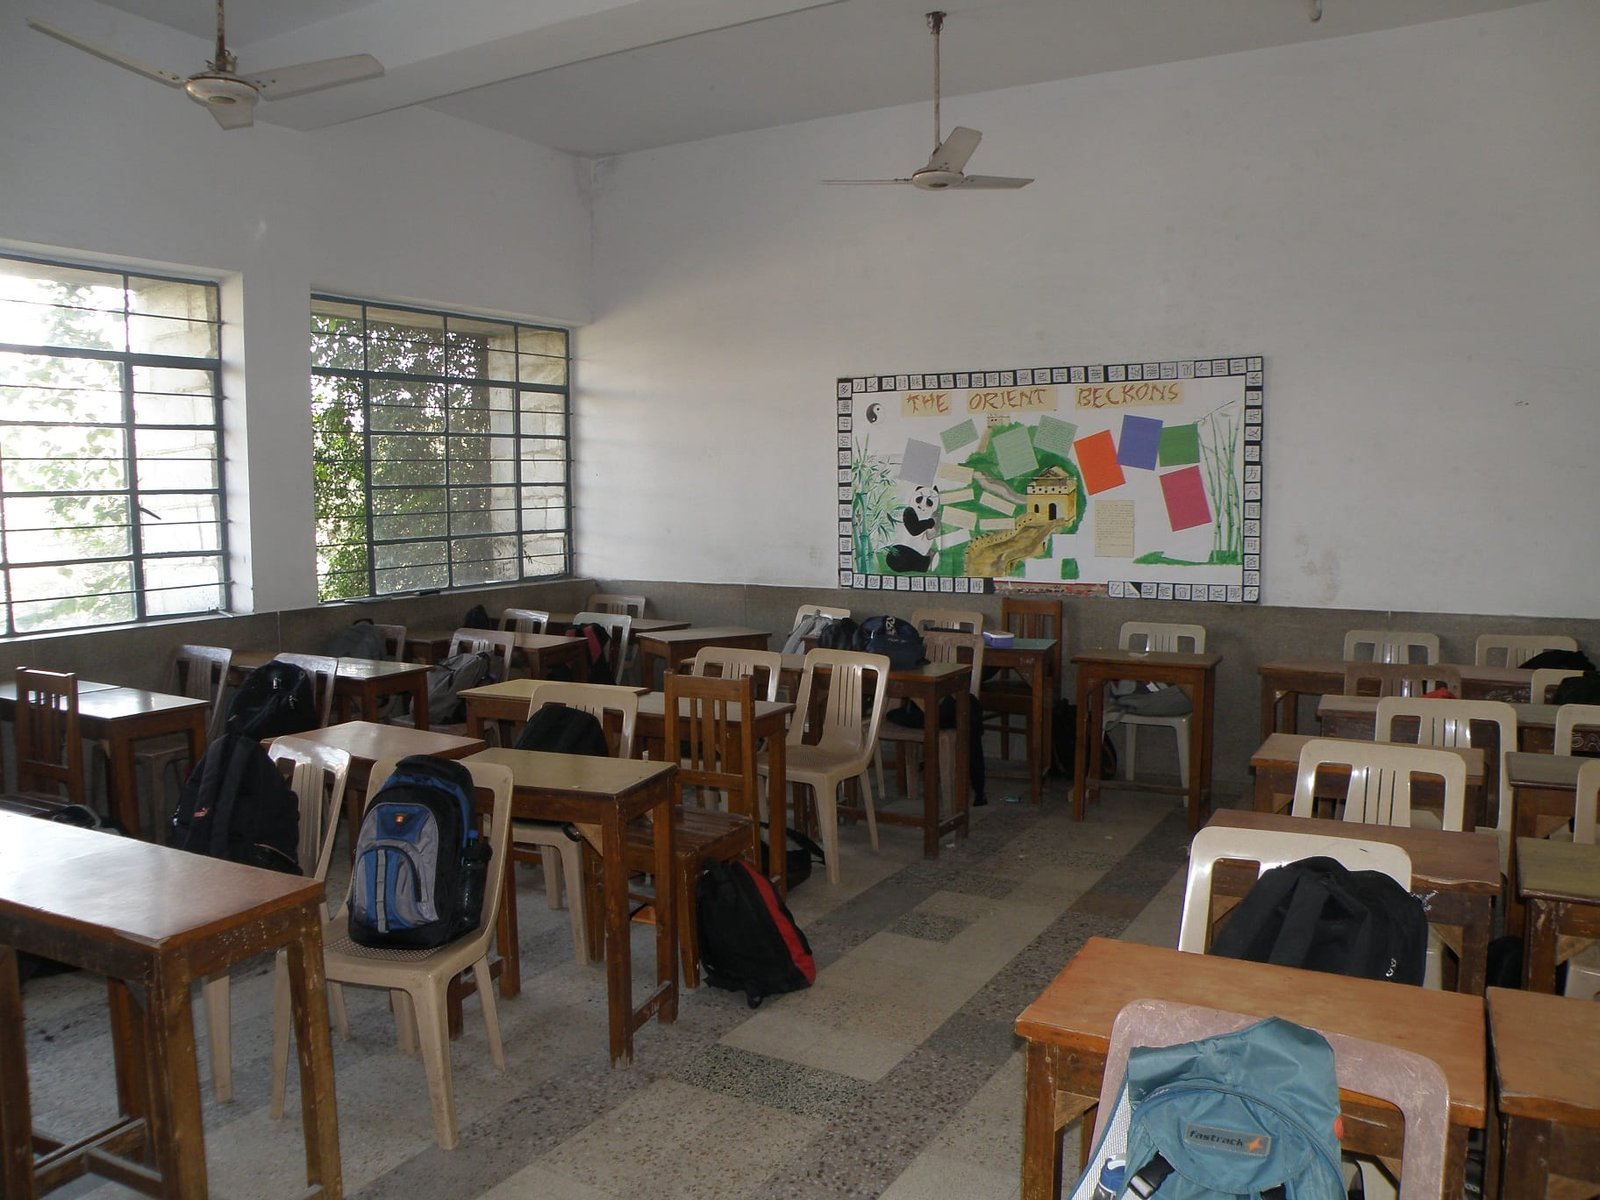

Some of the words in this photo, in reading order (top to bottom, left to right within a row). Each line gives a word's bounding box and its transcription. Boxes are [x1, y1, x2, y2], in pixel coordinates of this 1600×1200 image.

[907, 393, 949, 413] THE
[969, 388, 1048, 410] ORIENT
[1077, 383, 1180, 408] BECKONS
